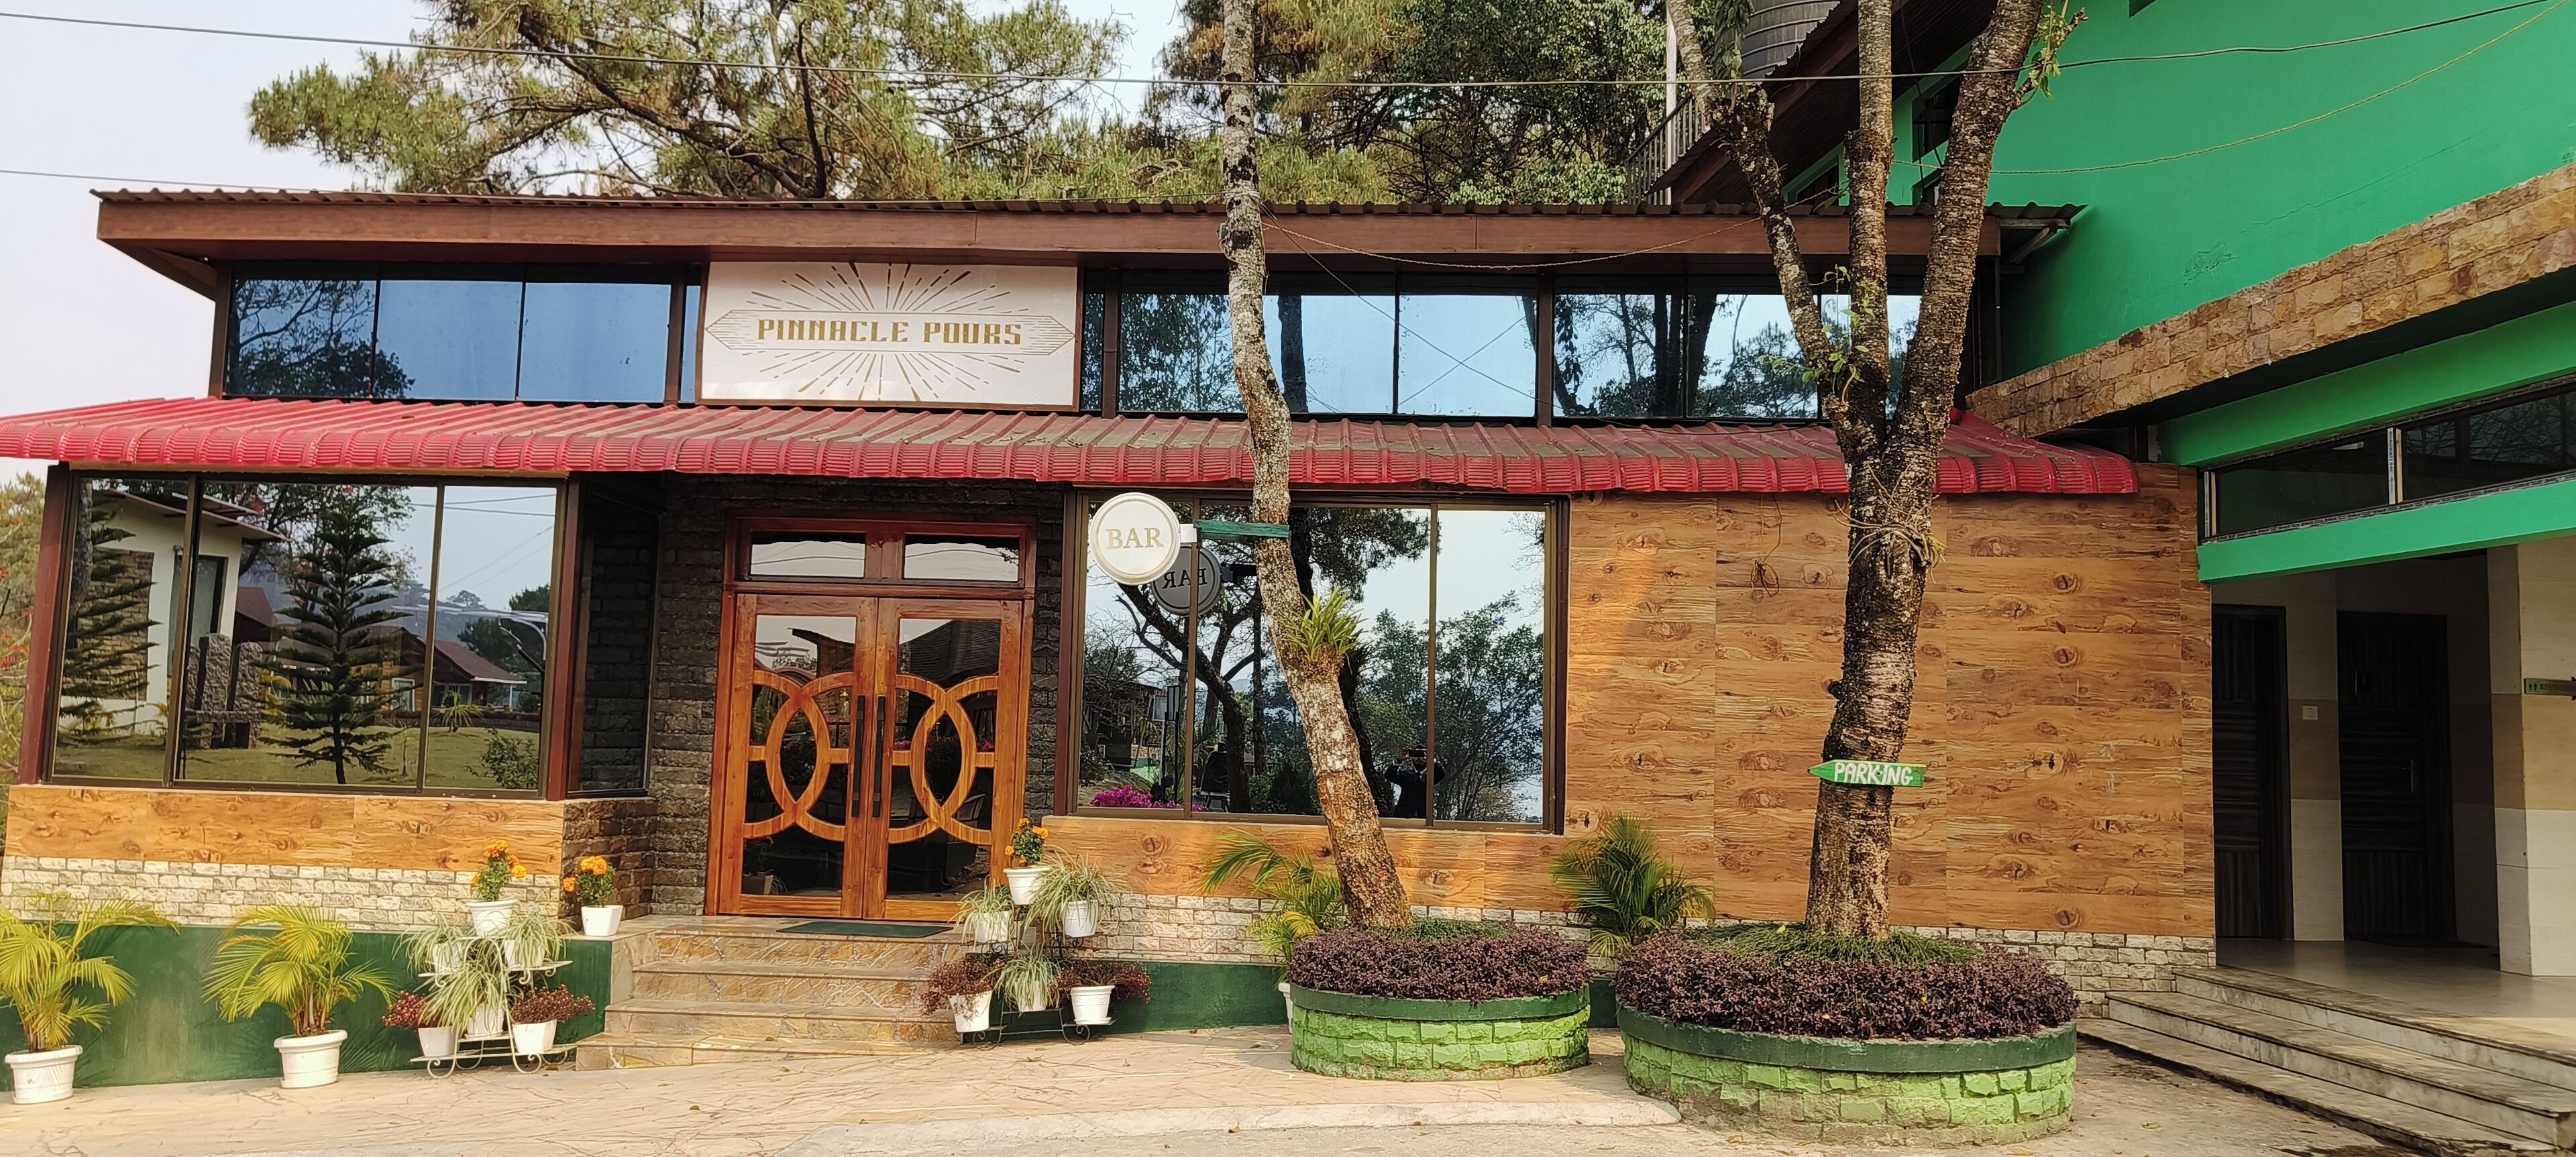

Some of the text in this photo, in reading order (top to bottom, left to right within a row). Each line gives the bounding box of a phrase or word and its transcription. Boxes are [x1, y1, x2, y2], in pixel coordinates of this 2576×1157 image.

[757, 319, 1022, 345] PINNACLE POURS
[1106, 527, 1165, 549] BAR
[1833, 762, 1913, 785] PARKING
